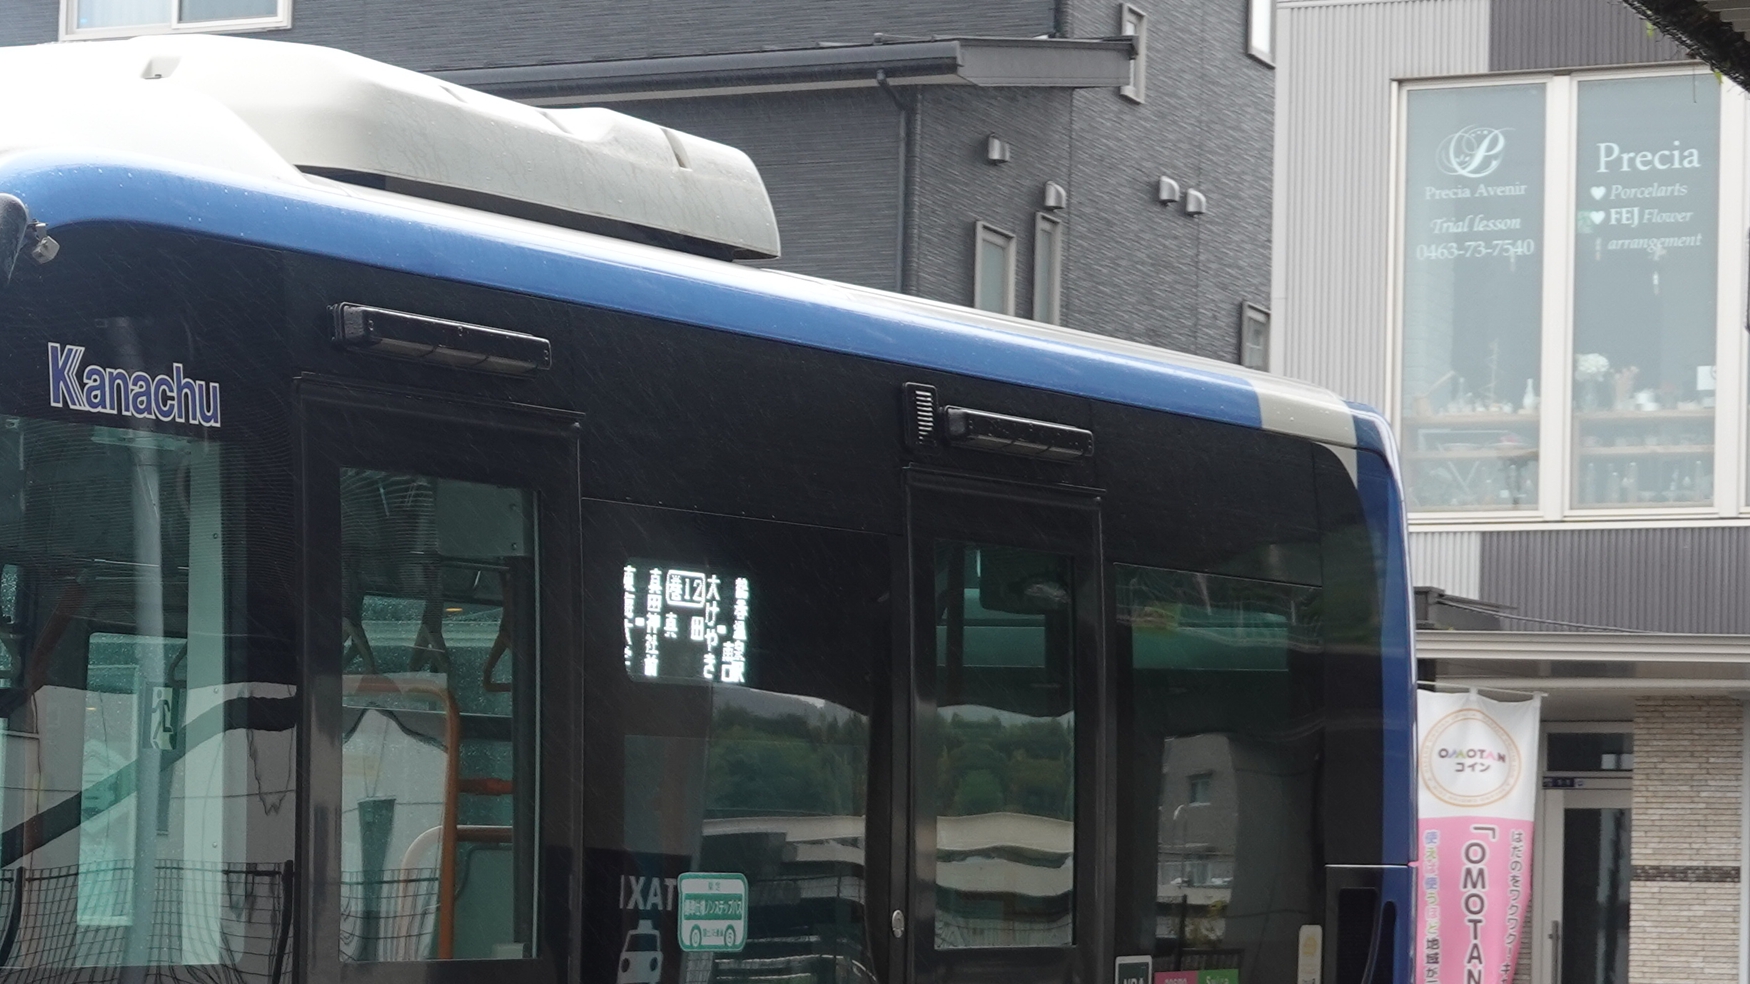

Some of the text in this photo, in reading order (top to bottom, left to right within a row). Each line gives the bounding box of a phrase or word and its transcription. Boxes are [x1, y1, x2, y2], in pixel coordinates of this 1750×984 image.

[1596, 140, 1701, 173] Precia
[1425, 182, 1527, 200] Precia Avenir
[1610, 182, 1688, 200] Porcelarts
[1430, 214, 1521, 234] Trial lesson
[1609, 207, 1694, 228] FEJ Flower
[1416, 239, 1534, 260] 0463-73-7540
[1607, 233, 1702, 253] arrangement
[48, 342, 221, 427] Kanachu
[668, 574, 703, 602] 巻12
[644, 568, 663, 677] 真田神社前
[703, 574, 721, 679] 大けやき
[1438, 747, 1507, 763] OMOTAN
[1455, 762, 1491, 772] コイン
